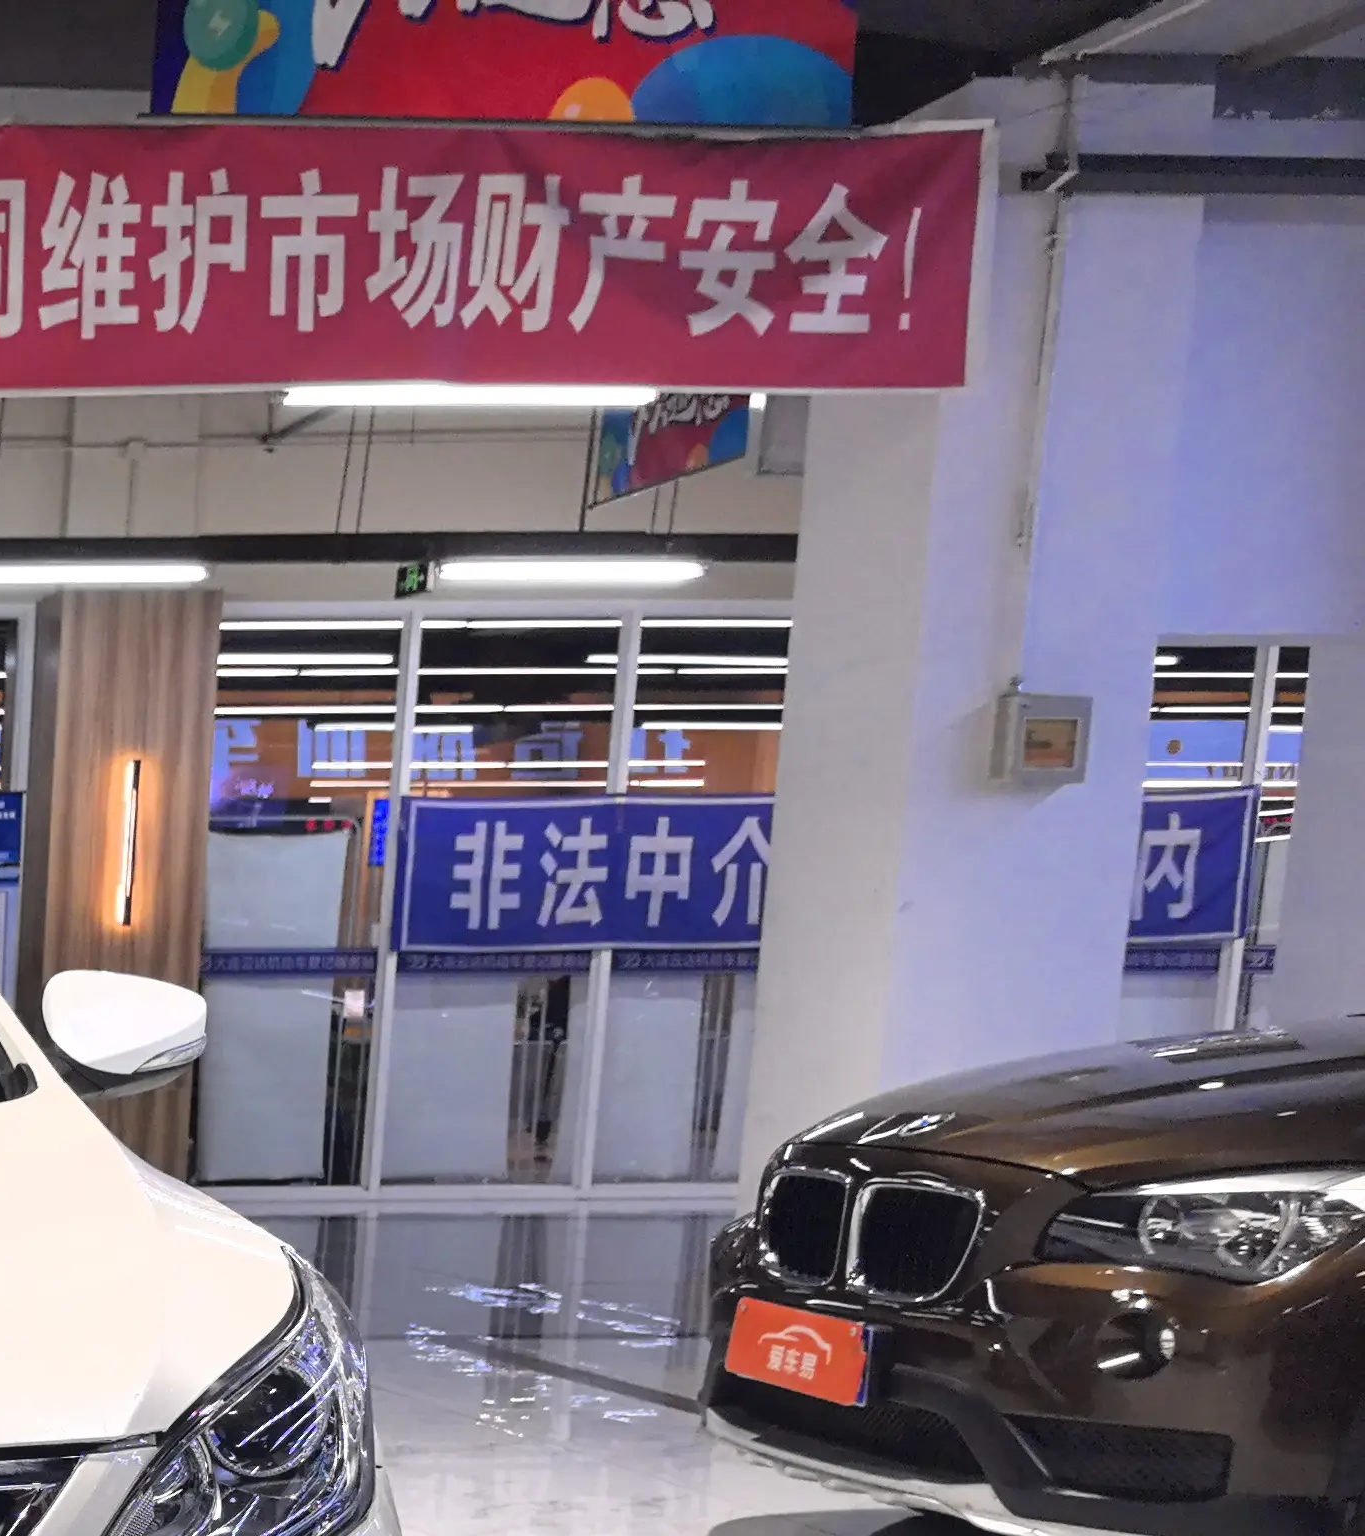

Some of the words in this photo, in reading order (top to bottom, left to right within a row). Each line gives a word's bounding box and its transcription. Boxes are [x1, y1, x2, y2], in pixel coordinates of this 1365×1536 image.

[450, 814, 771, 931] 非法中介
[1130, 812, 1202, 921] 内
